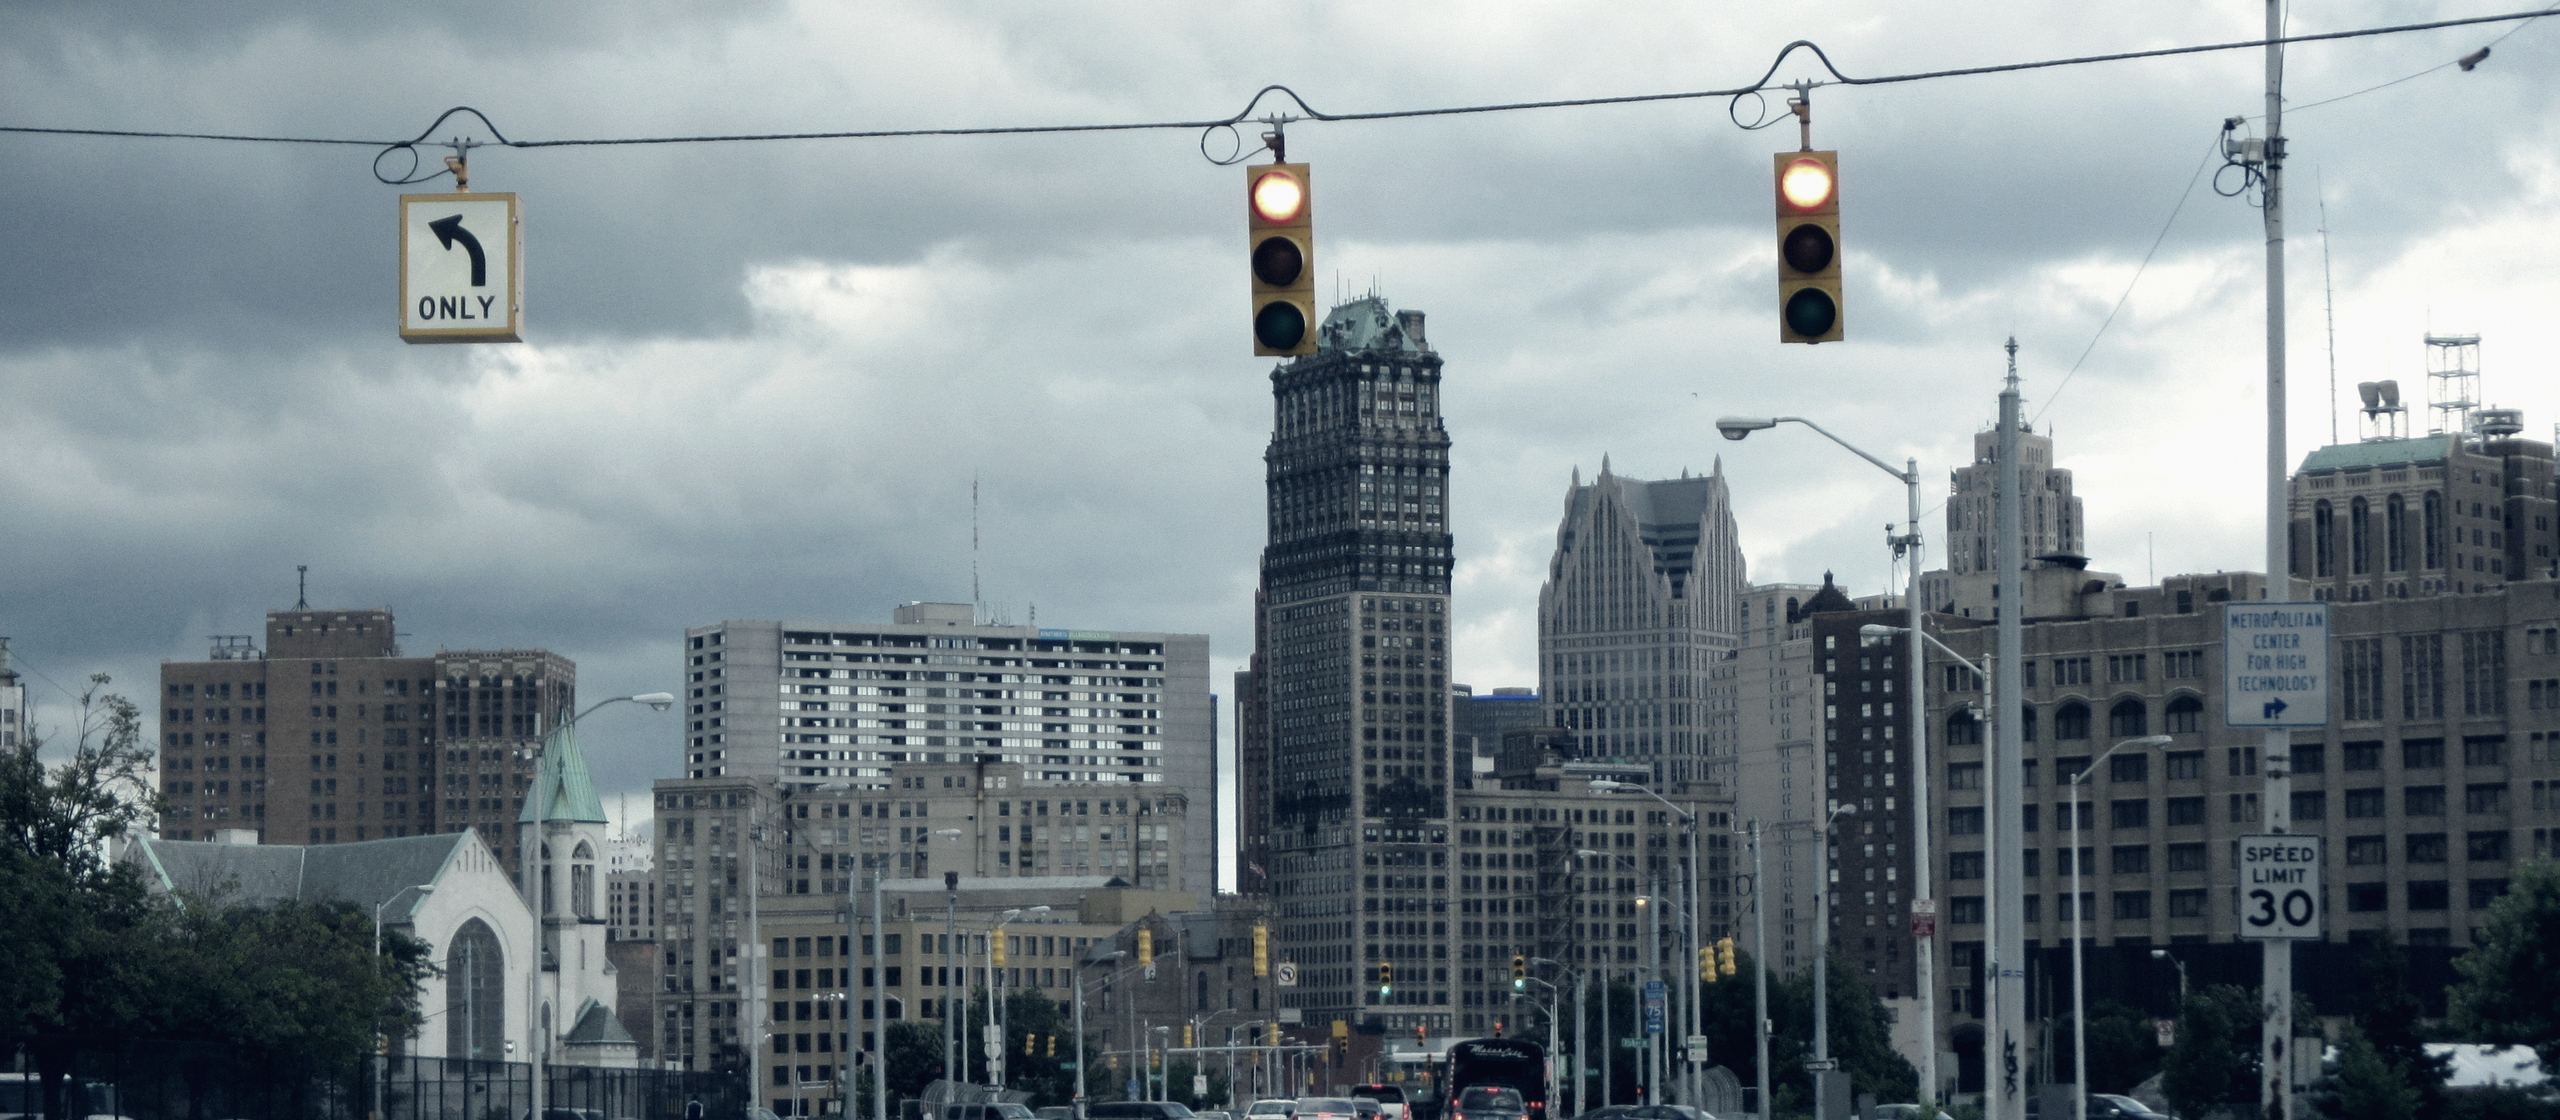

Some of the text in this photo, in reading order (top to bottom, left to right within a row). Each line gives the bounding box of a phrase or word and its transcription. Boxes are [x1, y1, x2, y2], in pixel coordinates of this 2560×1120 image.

[418, 295, 496, 321] ONLY
[2231, 611, 2323, 628] METROPOLITAN
[2253, 633, 2300, 649] CENTER
[2247, 654, 2306, 670] FOR HIGH
[2238, 675, 2317, 692] TECHNOLOGY
[2246, 846, 2314, 862] SPEED
[2252, 867, 2306, 884] LIMIT
[2247, 888, 2314, 927] 30
[1647, 1005, 1661, 1017] 75
